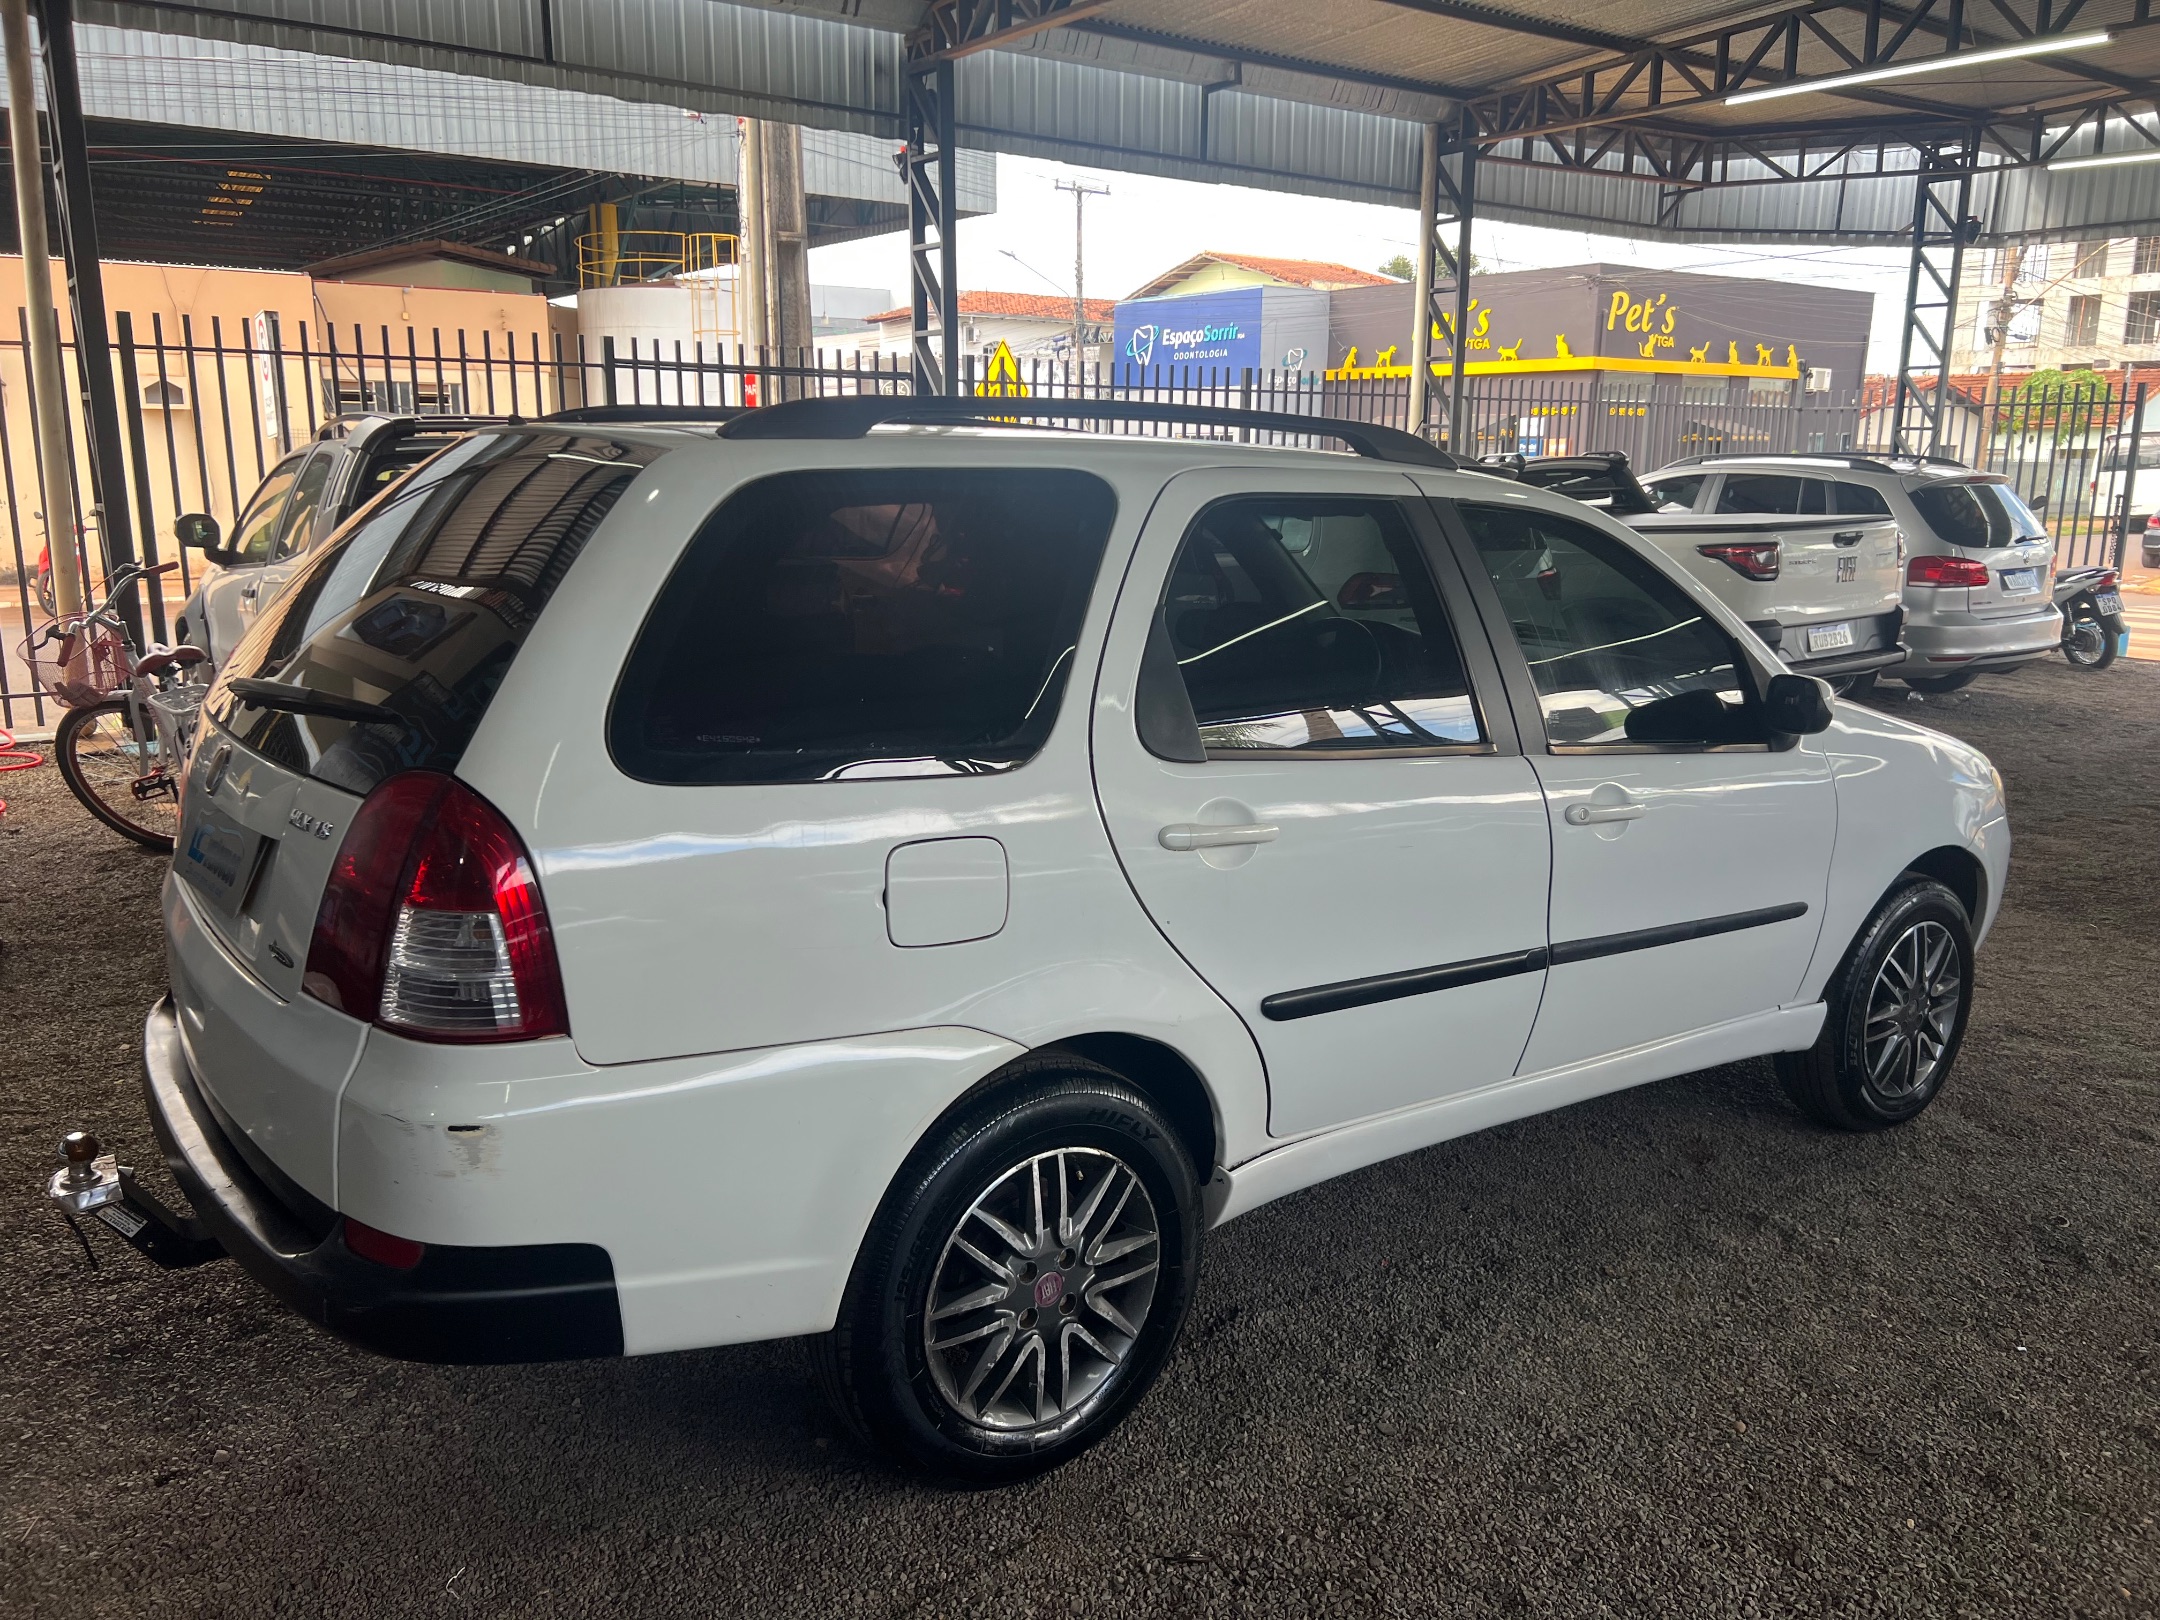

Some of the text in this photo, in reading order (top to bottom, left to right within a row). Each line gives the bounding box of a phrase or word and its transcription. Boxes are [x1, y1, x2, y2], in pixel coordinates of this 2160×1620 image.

[1607, 291, 1676, 334] Pet's
[1173, 348, 1228, 361] ODONTOLOGIA
[1086, 1107, 1160, 1140] HIFLY
